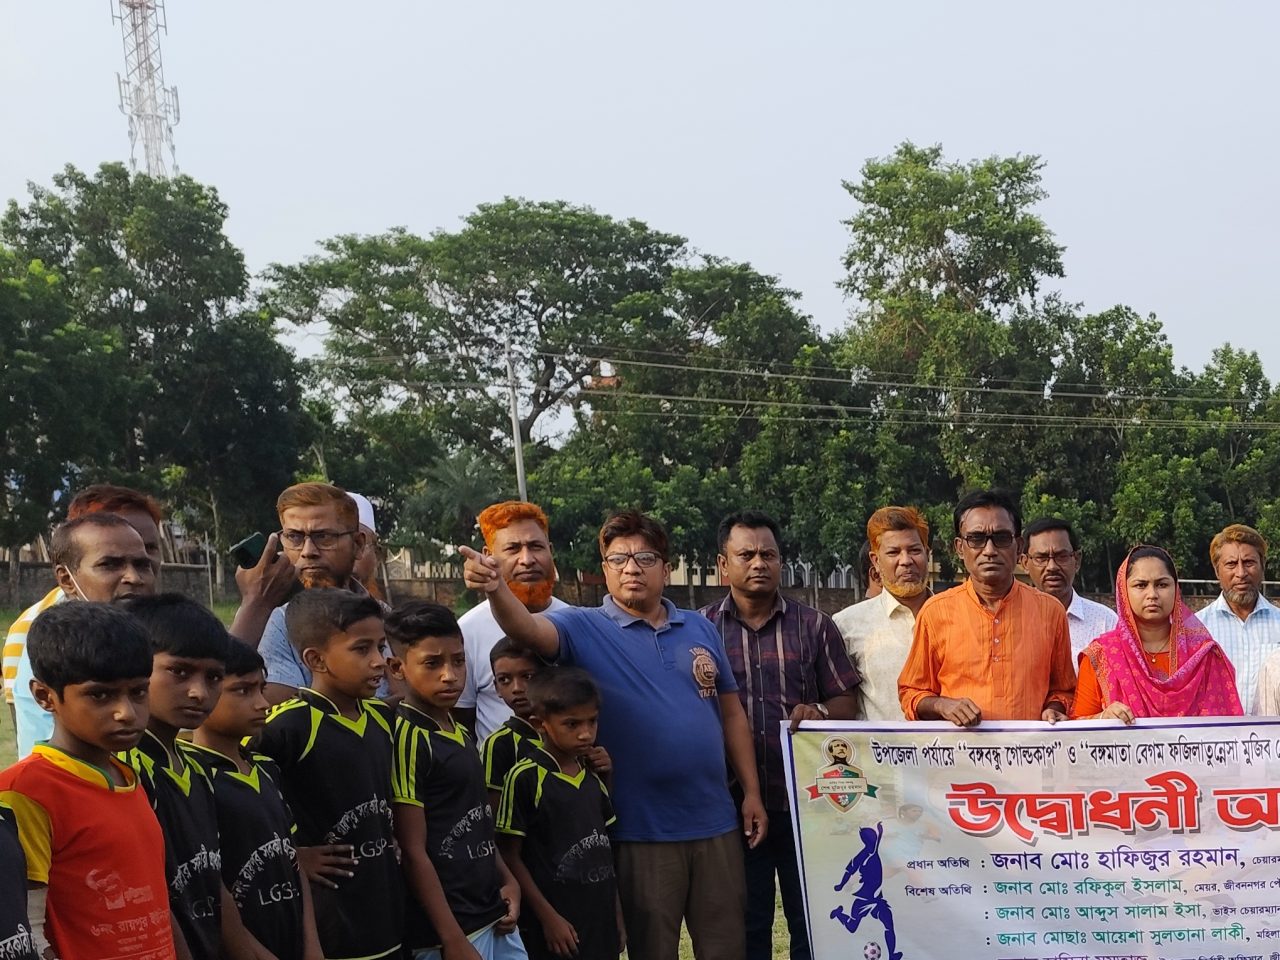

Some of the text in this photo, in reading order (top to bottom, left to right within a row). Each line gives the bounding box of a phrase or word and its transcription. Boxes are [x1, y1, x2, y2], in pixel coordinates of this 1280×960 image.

[871, 738, 917, 766] উপজেলা
[1067, 748, 1077, 763] ও
[1136, 743, 1164, 765] বেগম
[1242, 732, 1270, 766] মুজিব
[945, 770, 1200, 846] উদ্বোধনী
[907, 859, 934, 870] প্রধান
[937, 857, 970, 869] অতিথি
[990, 851, 1043, 870] জনাব
[1051, 850, 1089, 870] মোঃ
[1096, 845, 1171, 871] হাফিজুর
[1178, 847, 1246, 869] রহমান,
[905, 885, 935, 897] বিশেষ
[939, 885, 972, 896] অতিথি
[993, 881, 1033, 895] জনাব
[1040, 881, 1068, 896] মোঃ
[1074, 877, 1126, 898] রফিকুল
[1131, 876, 1188, 897] ইসলাম,
[1223, 879, 1266, 891] জীবননগর
[995, 906, 1036, 921] জনাব
[1041, 906, 1070, 920] মোঃ
[1124, 903, 1168, 920] সালাম
[1173, 900, 1207, 919] ইসা,
[1213, 906, 1237, 917] ভাইস
[996, 931, 1037, 946] জনাব
[1043, 931, 1087, 946] মোছাঃ
[1092, 930, 1145, 945] আয়েশা
[1150, 927, 1205, 946] সুলতানা
[1211, 922, 1251, 943] লাকী,
[1256, 929, 1280, 940] মহিলা
